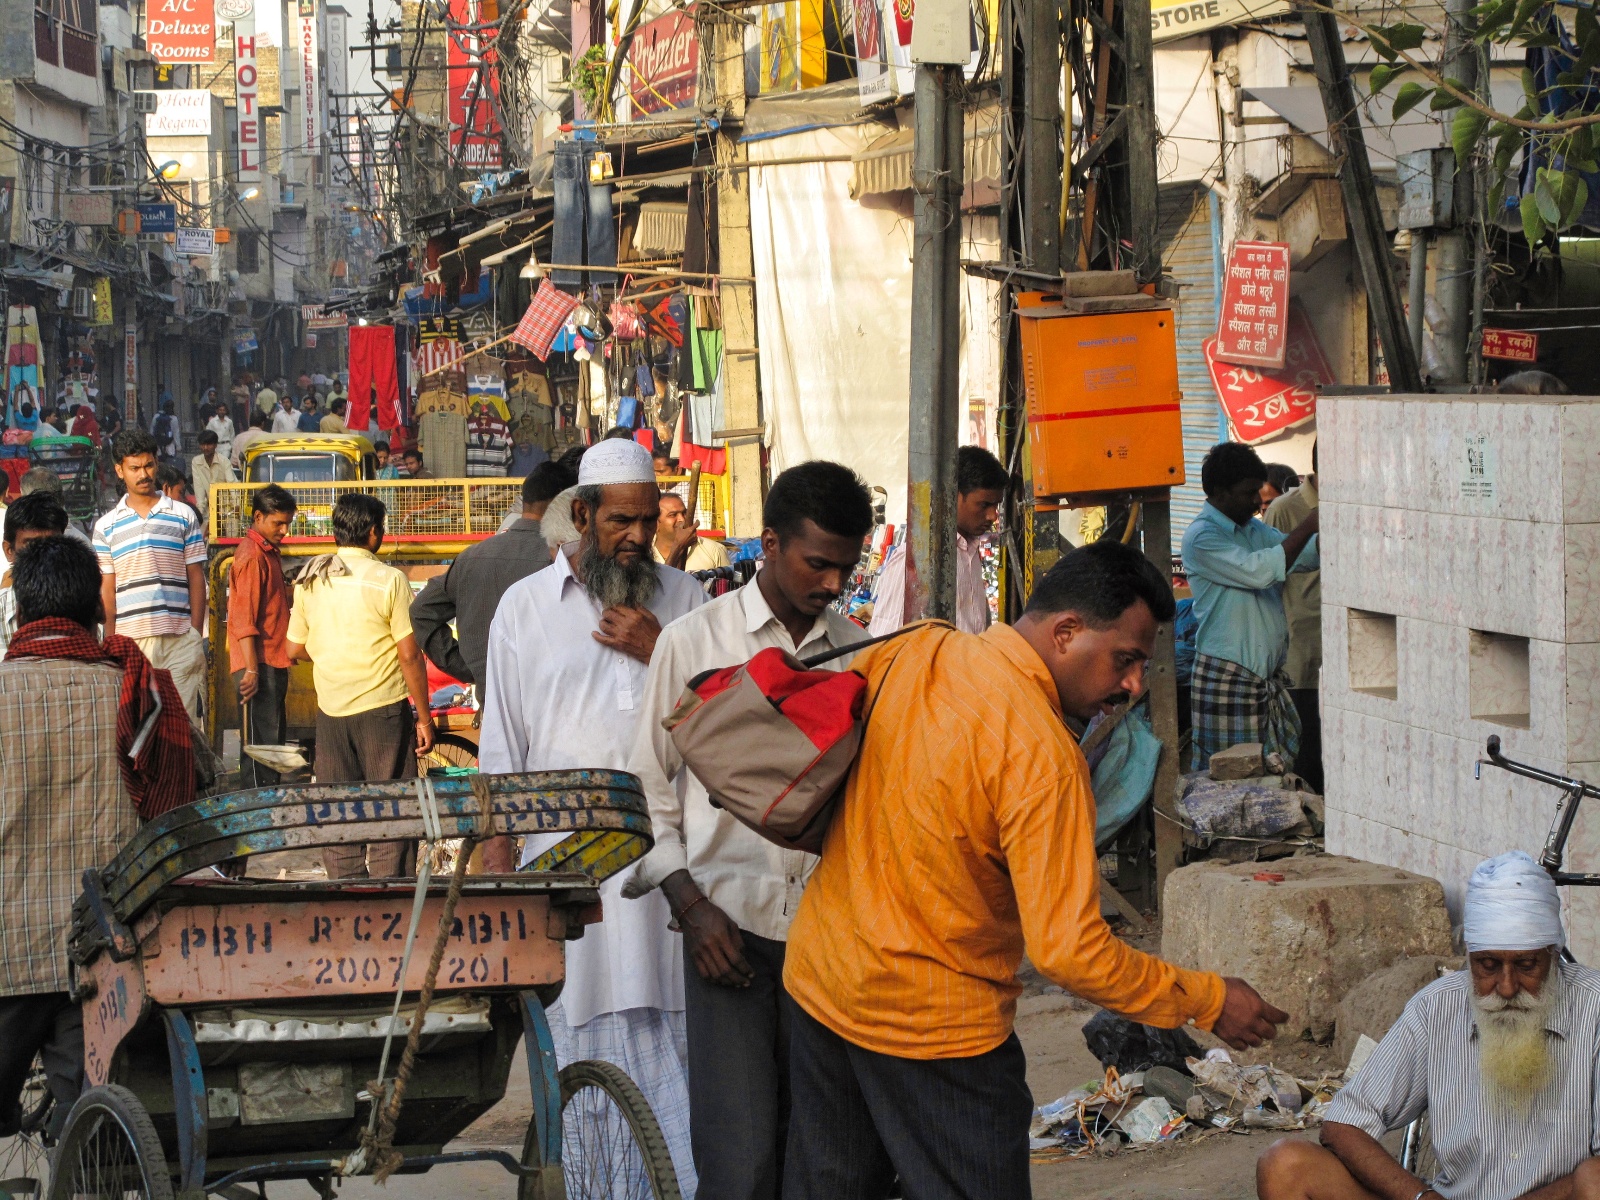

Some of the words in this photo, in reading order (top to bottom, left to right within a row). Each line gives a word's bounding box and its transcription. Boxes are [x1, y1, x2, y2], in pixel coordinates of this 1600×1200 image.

[161, 0, 197, 13] A/C
[1150, 0, 1220, 31] STORE
[149, 19, 211, 35] Deluxe
[151, 42, 210, 57] Rooms
[633, 16, 694, 84] Premier
[238, 36, 259, 171] HOTEL
[157, 116, 209, 133] Regency
[185, 230, 211, 238] ROYAL
[1237, 335, 1252, 350] और
[1254, 337, 1267, 354] दही
[181, 921, 272, 959] PBH
[315, 956, 404, 985] 2007
